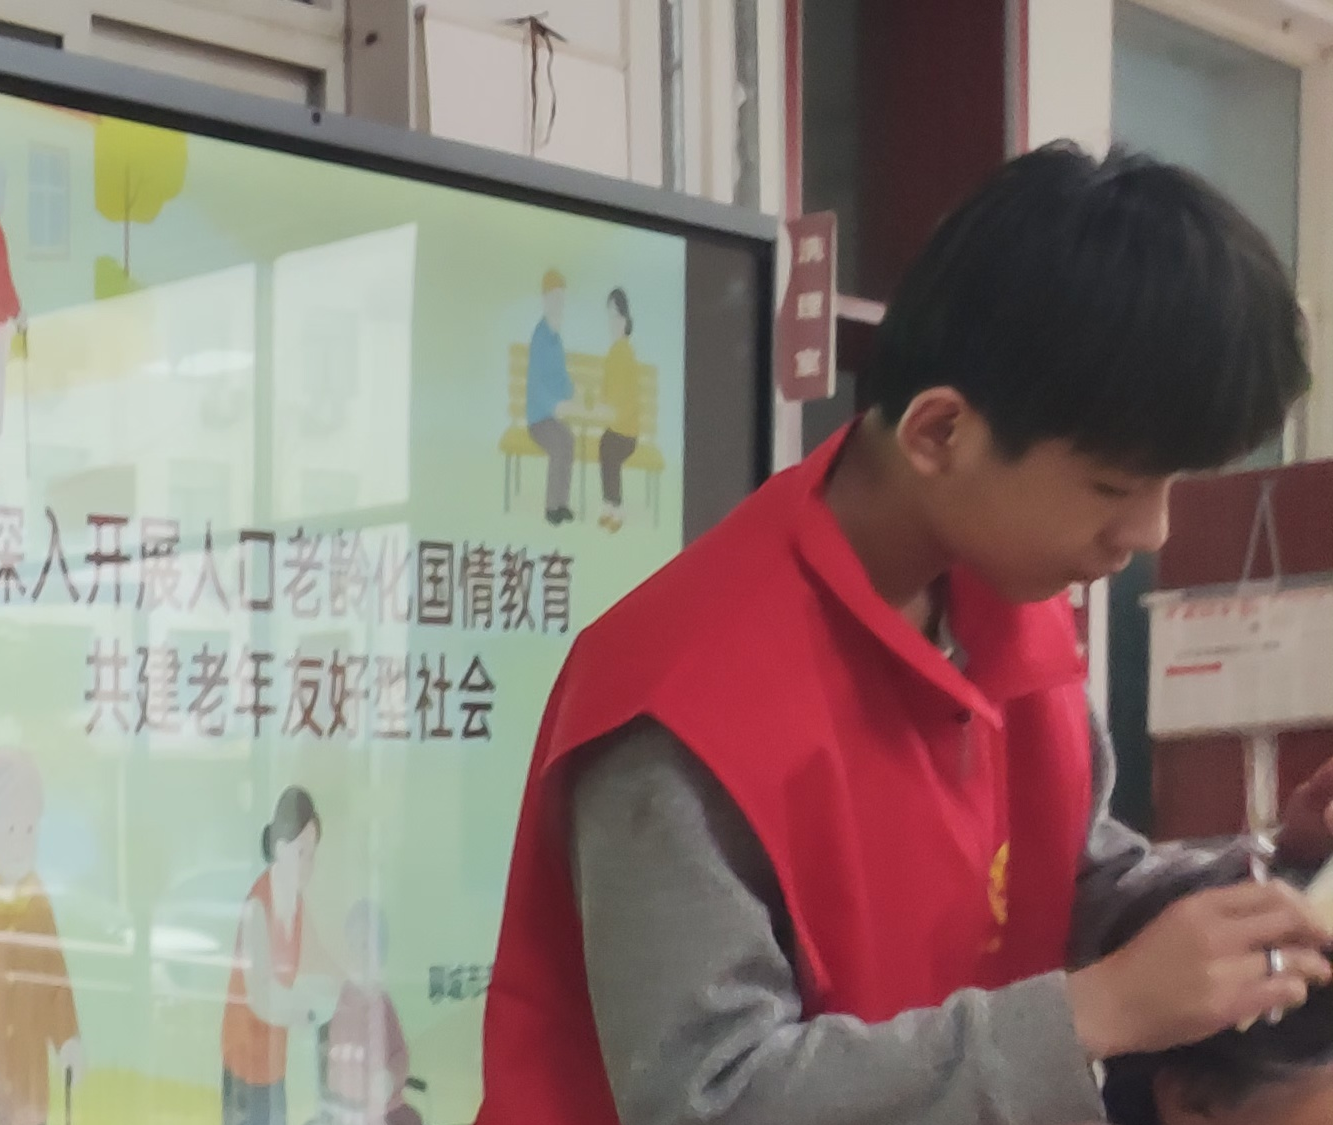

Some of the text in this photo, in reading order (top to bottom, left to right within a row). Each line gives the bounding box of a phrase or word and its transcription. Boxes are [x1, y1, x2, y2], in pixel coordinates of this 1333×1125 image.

[84, 638, 496, 741] 共建老年友好型社会
